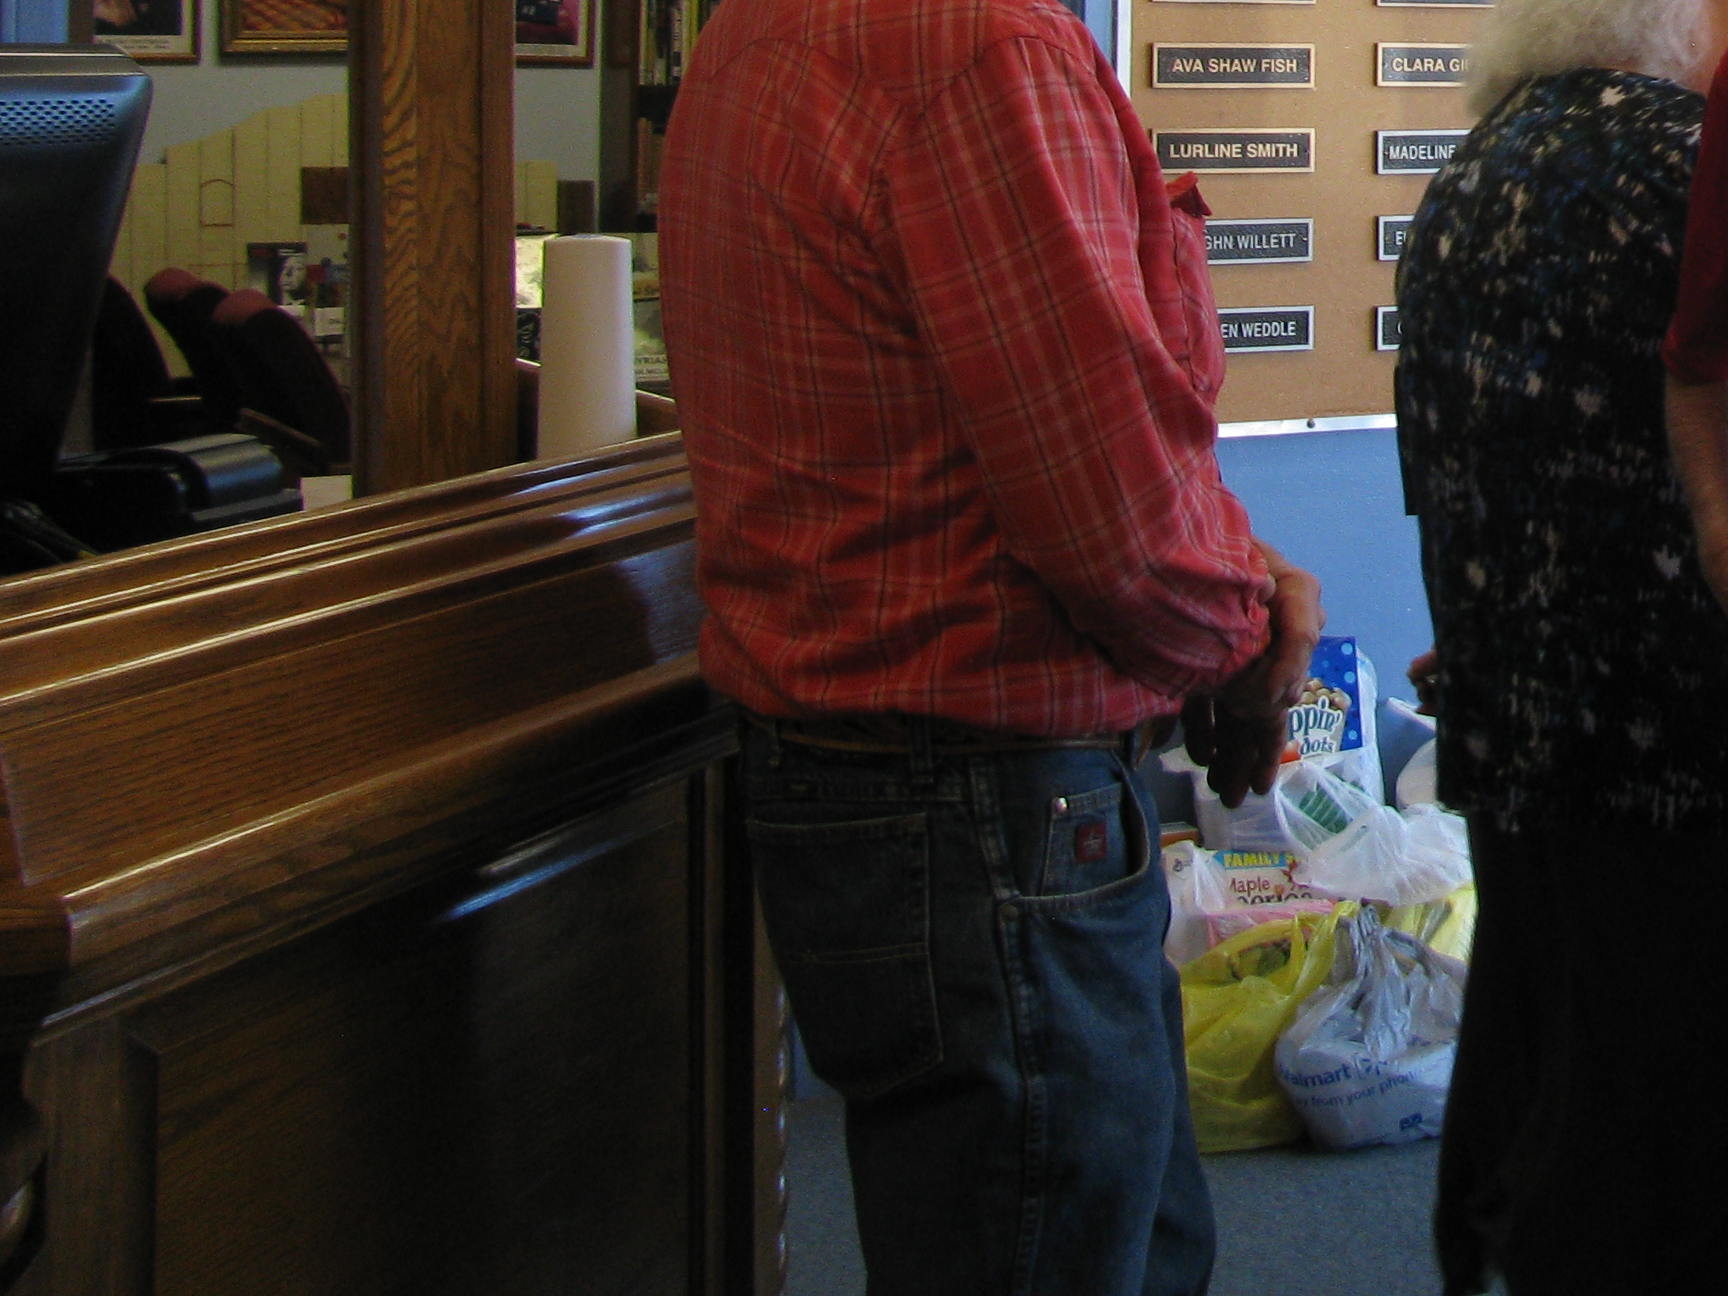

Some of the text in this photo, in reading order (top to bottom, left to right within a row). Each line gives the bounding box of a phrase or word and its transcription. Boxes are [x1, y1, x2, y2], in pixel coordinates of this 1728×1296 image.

[1172, 58, 1298, 73] AVA SHAW FISH
[1392, 57, 1446, 73] CLARA
[1169, 142, 1299, 159] LURLINE SMITH
[1205, 233, 1297, 250] GHN WILLETT
[1221, 321, 1297, 339] EN WEDDLE
[1288, 698, 1341, 740] ppin'
[1223, 852, 1280, 867] FAMILY
